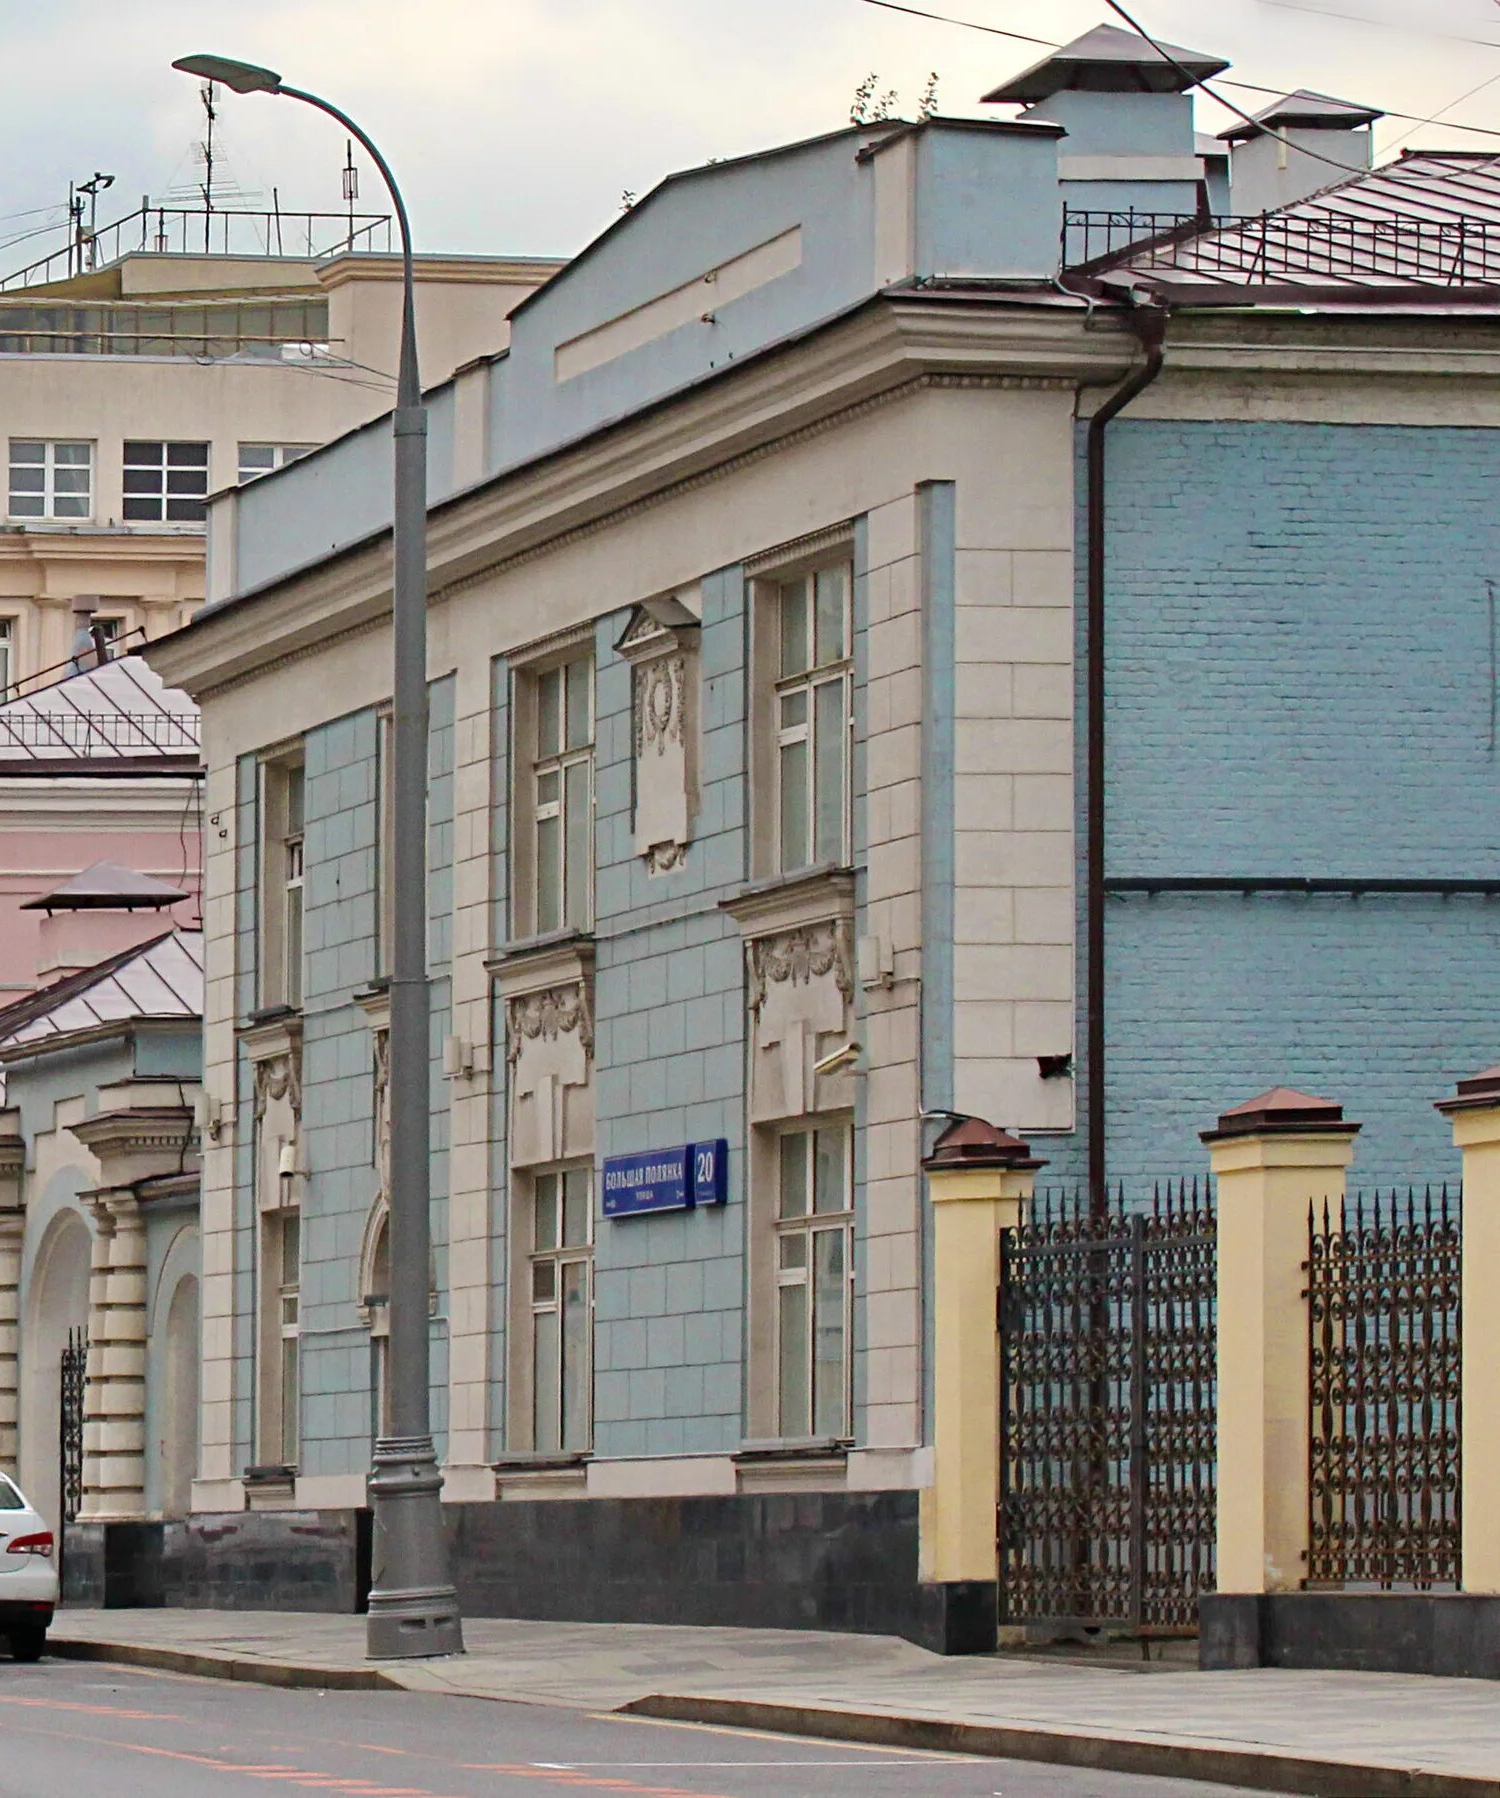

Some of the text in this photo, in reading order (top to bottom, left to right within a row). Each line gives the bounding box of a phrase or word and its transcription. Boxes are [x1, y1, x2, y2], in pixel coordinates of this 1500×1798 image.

[606, 1162, 683, 1190] БОЛЬШАЯ ПОЛЯНКА
[697, 1151, 713, 1183] 20
